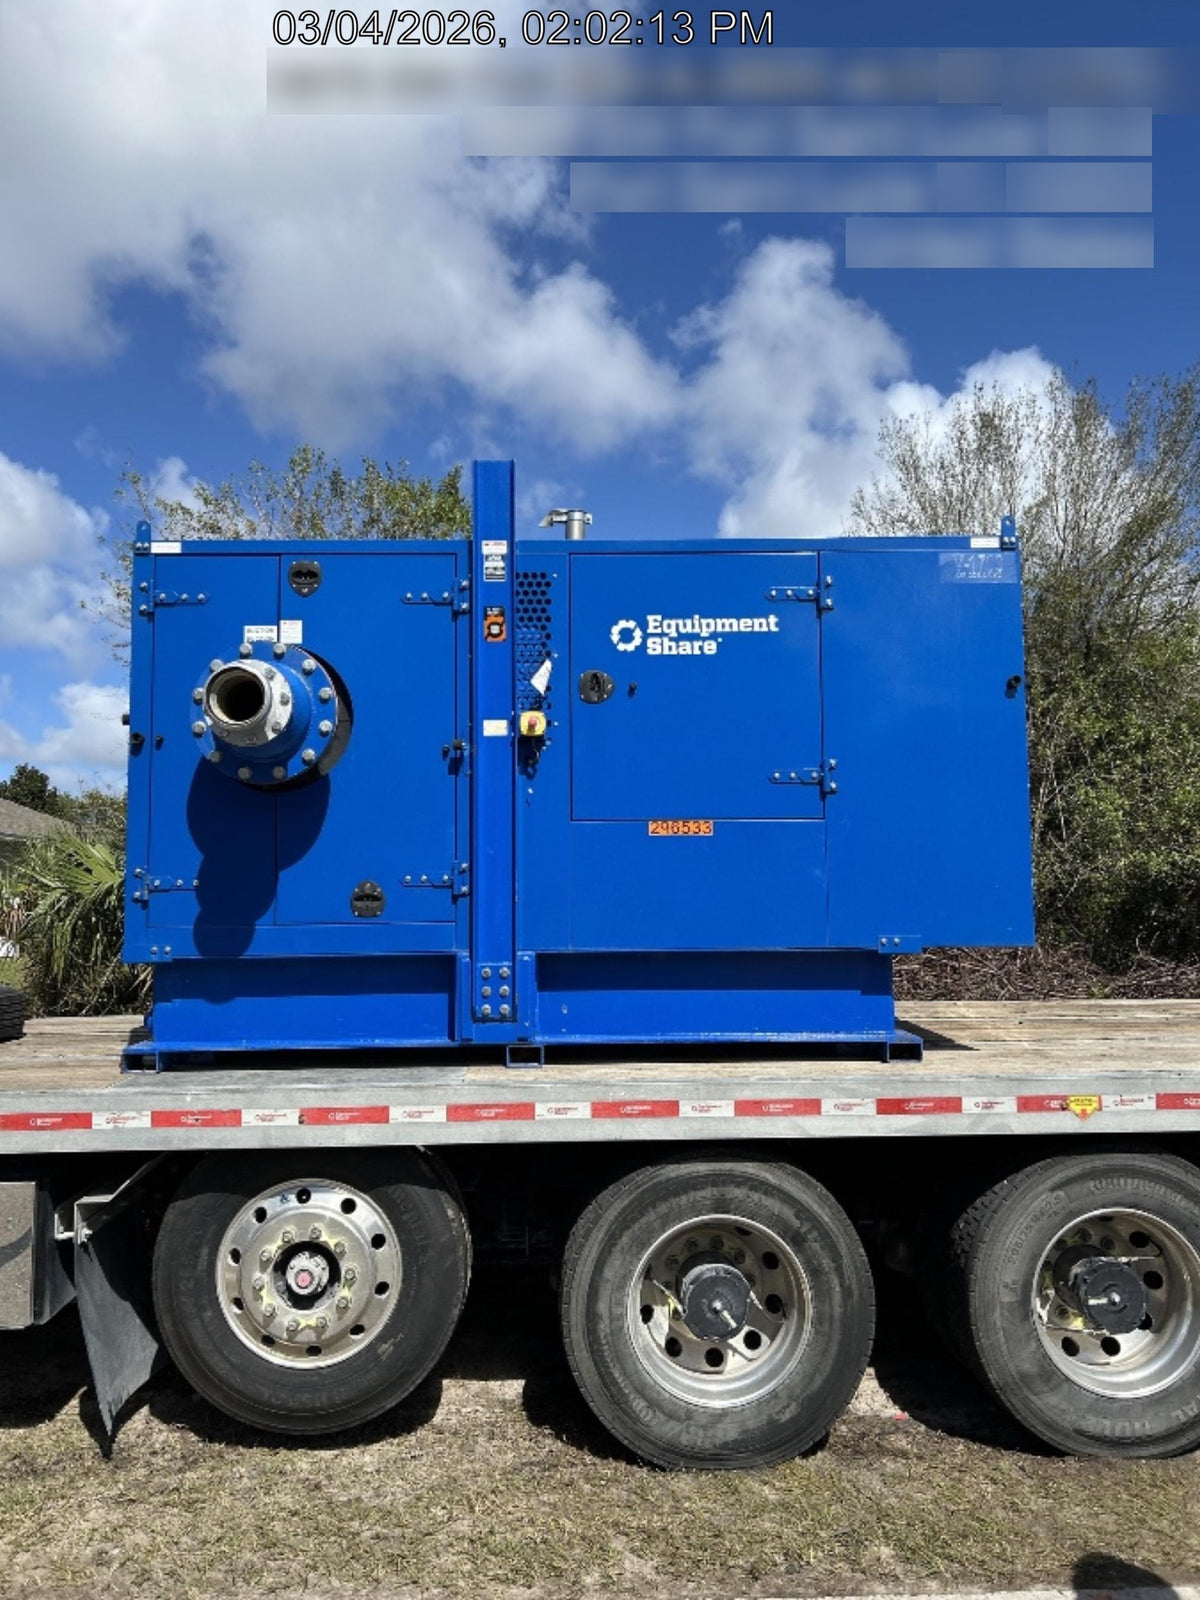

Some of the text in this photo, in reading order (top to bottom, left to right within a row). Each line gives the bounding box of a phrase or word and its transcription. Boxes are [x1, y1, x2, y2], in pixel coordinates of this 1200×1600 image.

[647, 614, 779, 636] Equipment
[647, 637, 717, 655] Share
[650, 820, 712, 835] 296533
